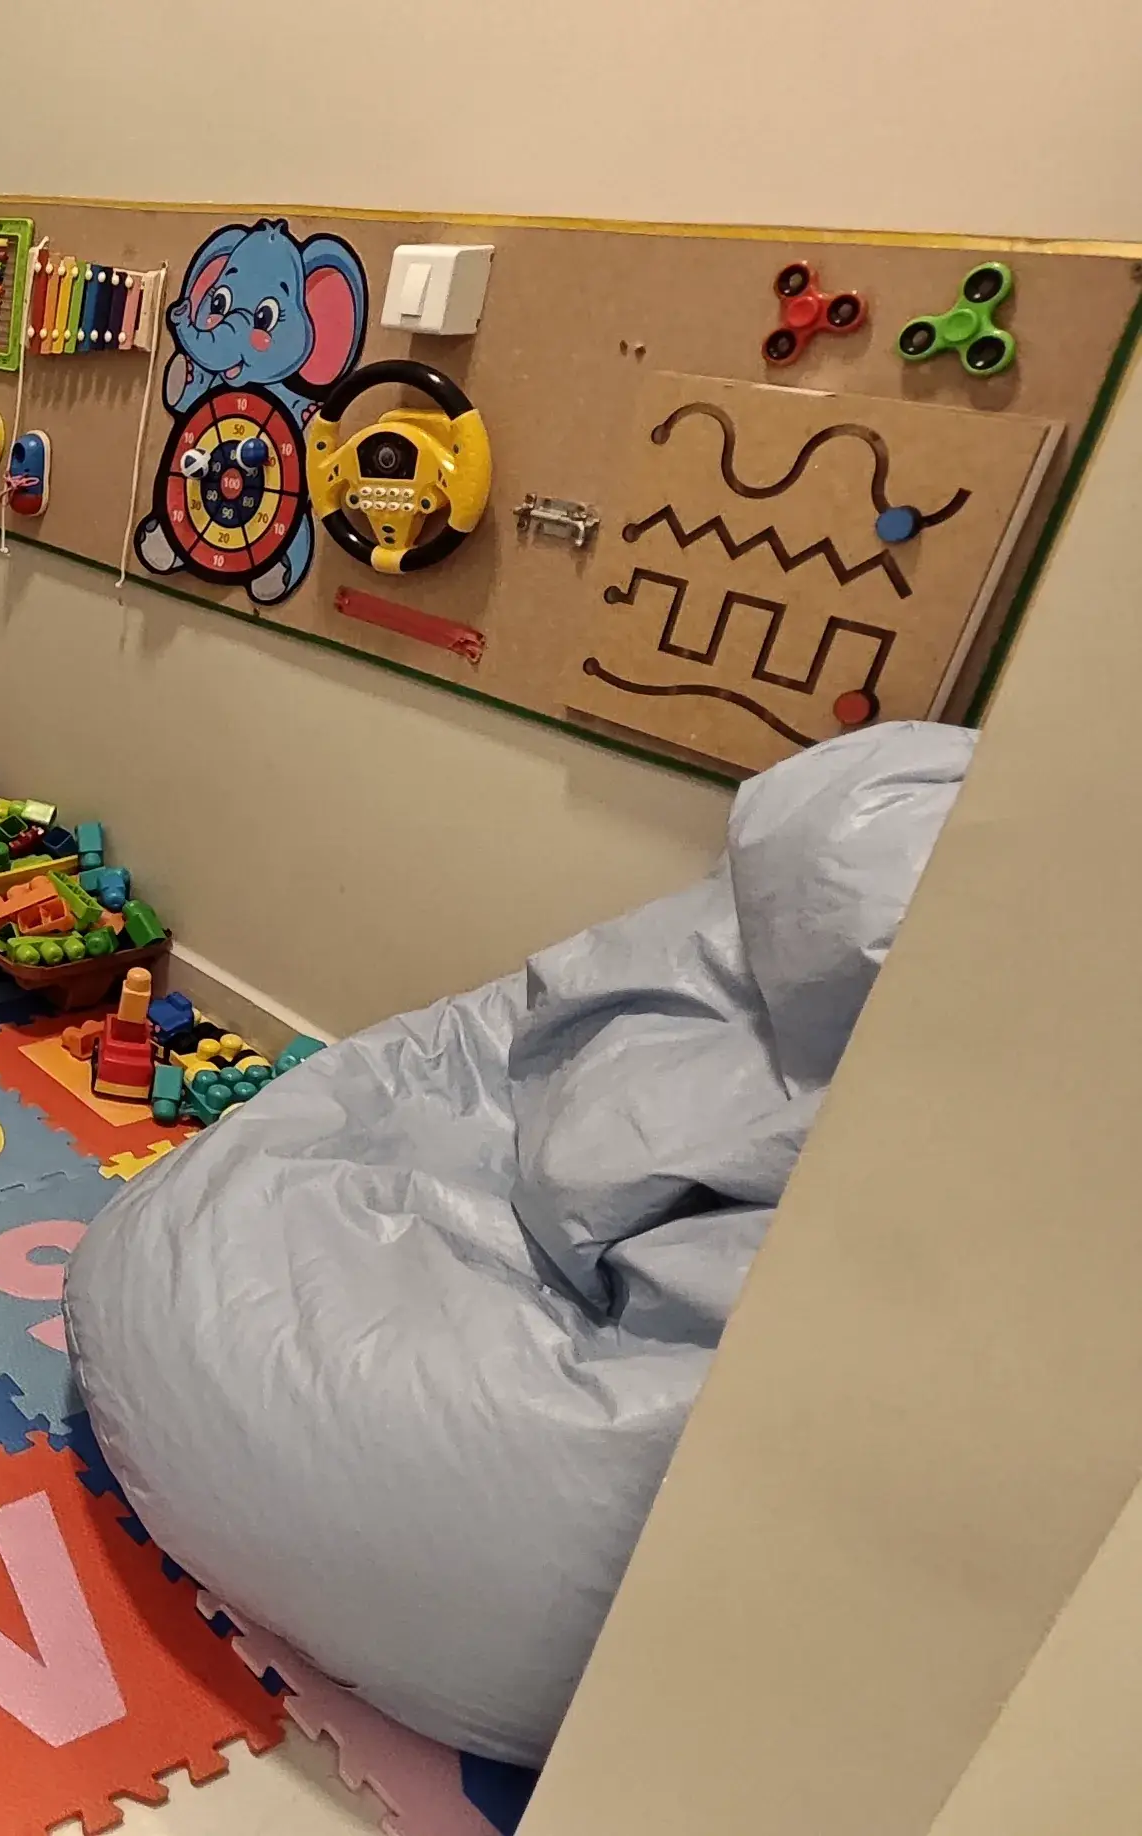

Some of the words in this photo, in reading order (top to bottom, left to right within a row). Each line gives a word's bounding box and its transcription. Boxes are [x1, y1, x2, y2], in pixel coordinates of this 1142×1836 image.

[237, 398, 249, 411] 10
[233, 424, 245, 436] 50
[183, 432, 194, 444] 10
[282, 443, 293, 456] 10
[224, 477, 240, 489] 100
[172, 510, 184, 522] 10
[222, 507, 235, 520] 90
[257, 512, 269, 524] 70
[273, 522, 285, 536] 10
[218, 532, 230, 544] 20
[212, 554, 225, 567] 10
